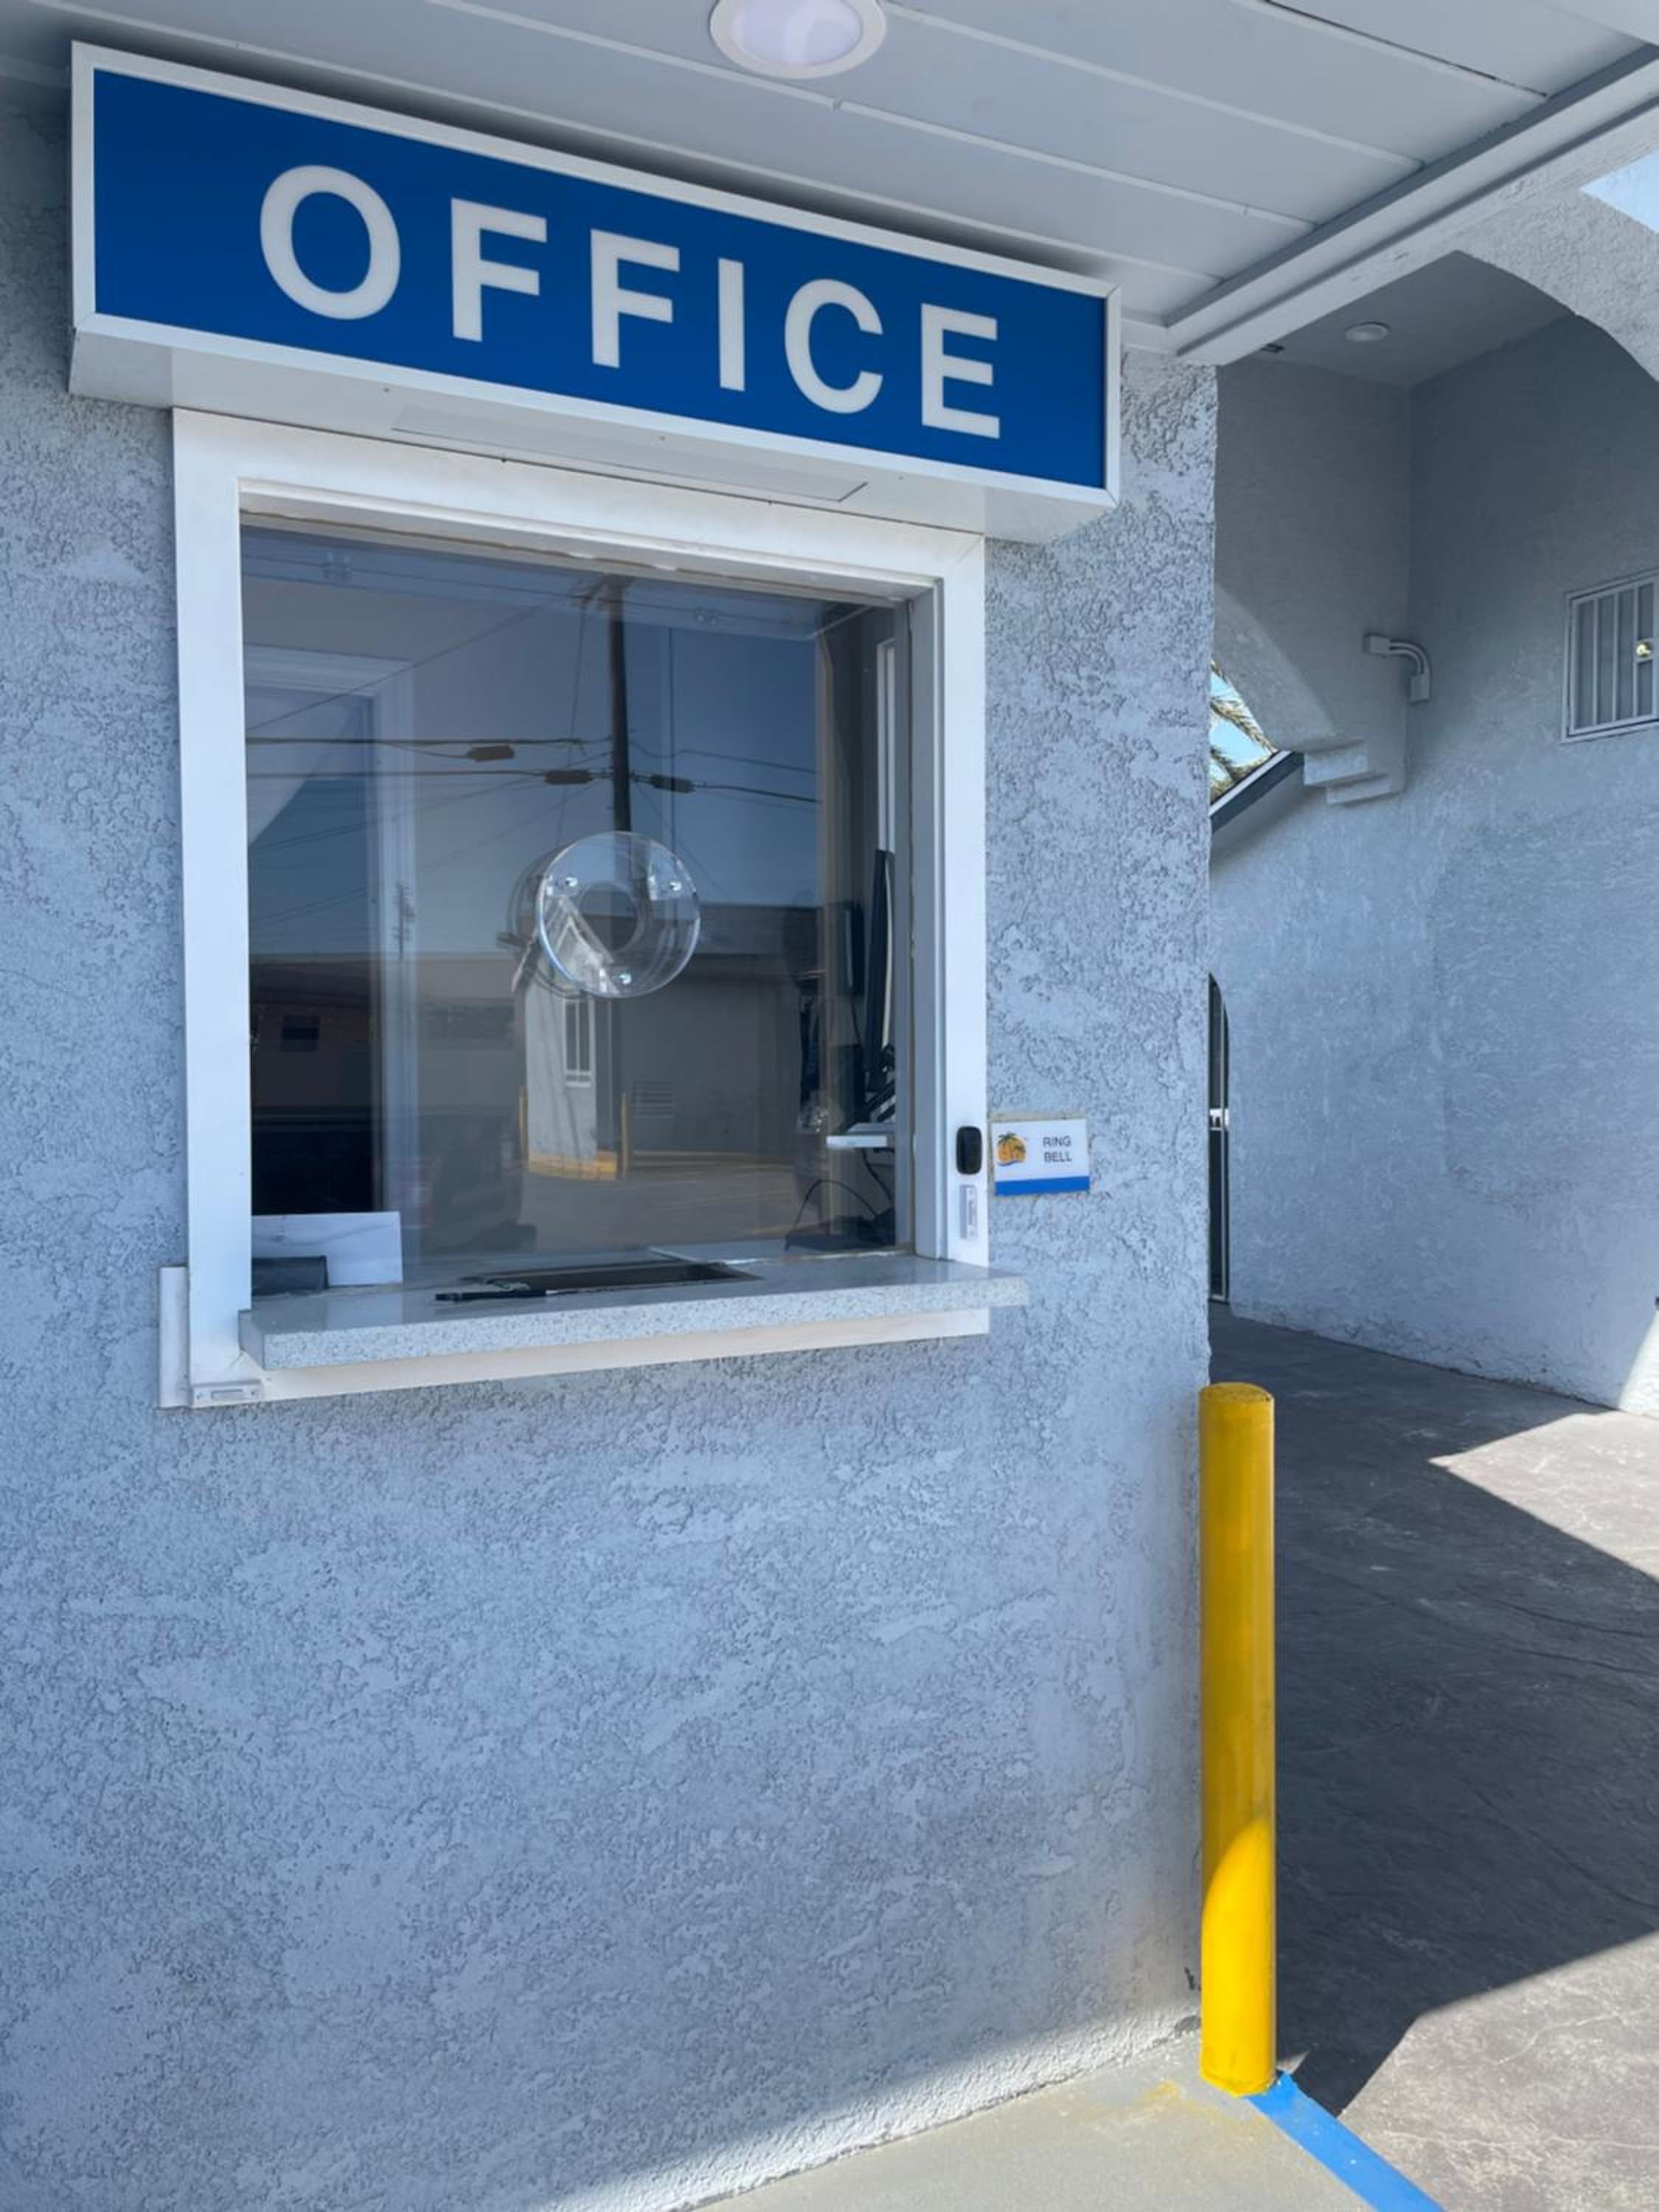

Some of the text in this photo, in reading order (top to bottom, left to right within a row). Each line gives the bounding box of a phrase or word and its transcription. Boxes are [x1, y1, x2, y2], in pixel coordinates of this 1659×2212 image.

[260, 165, 1000, 438] OFFICE
[1043, 1136, 1071, 1147] RING
[1044, 1151, 1072, 1162] BELL
